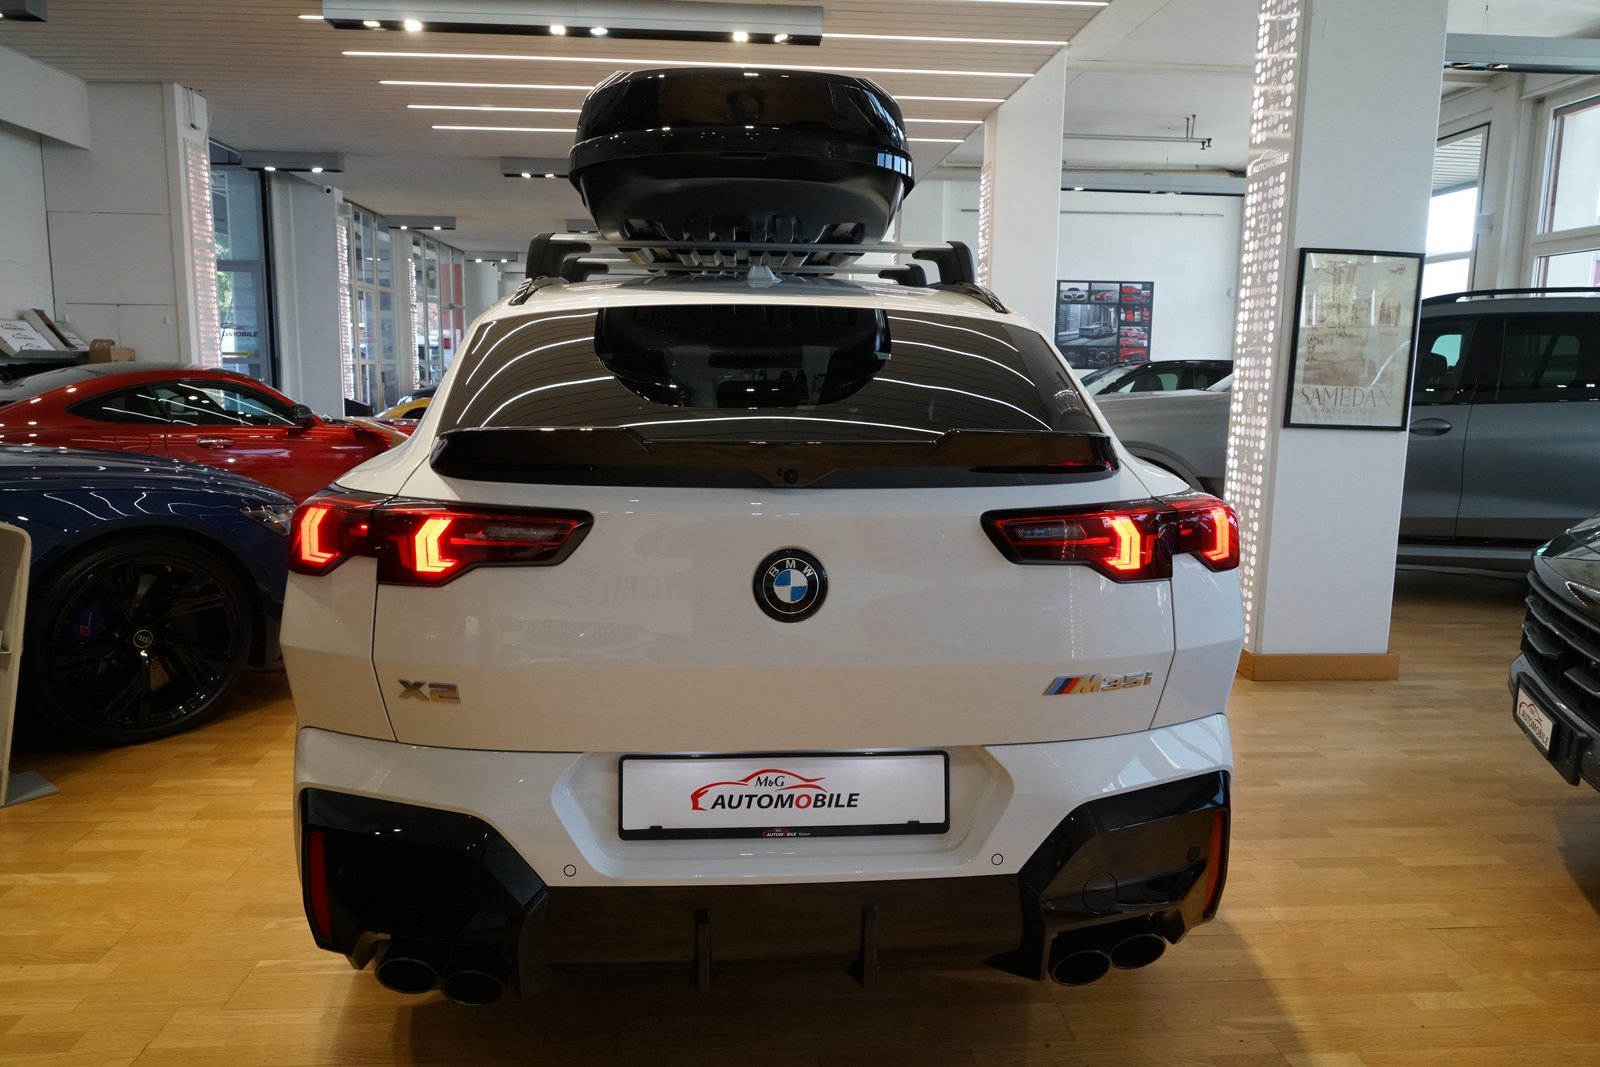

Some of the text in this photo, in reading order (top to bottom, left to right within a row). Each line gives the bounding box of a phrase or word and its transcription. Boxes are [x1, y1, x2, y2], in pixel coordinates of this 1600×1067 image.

[1301, 386, 1392, 407] SAMEDAN
[768, 559, 814, 578] BMW
[398, 679, 461, 704] X2
[1064, 670, 1153, 695] M35i
[1521, 710, 1549, 746] AUTOMOBILE
[755, 775, 785, 788] M&G
[711, 792, 860, 810] AUTOMOBILE
